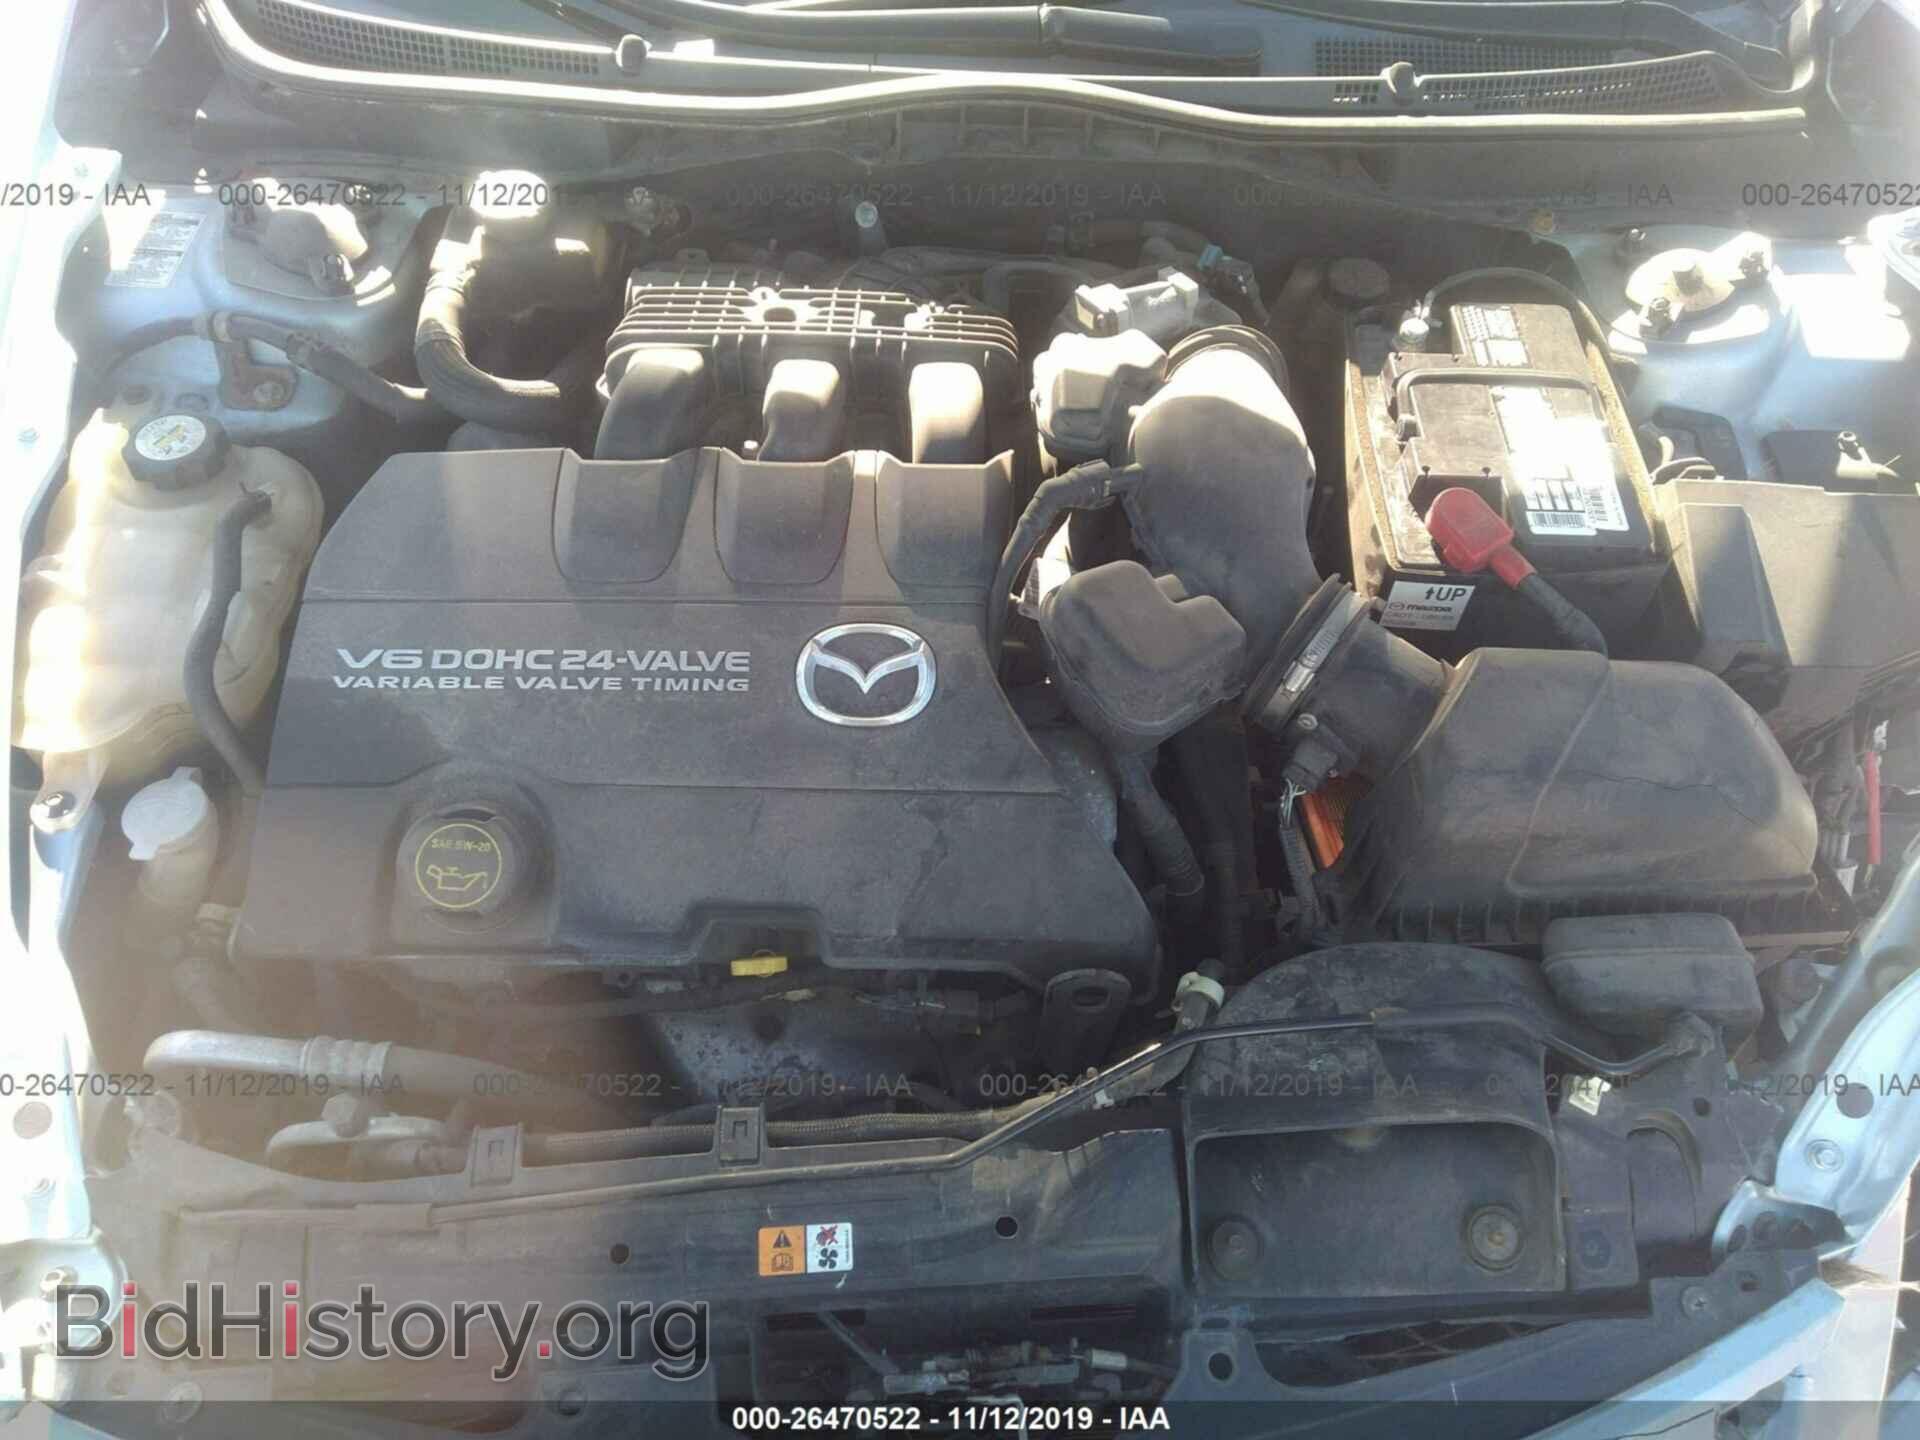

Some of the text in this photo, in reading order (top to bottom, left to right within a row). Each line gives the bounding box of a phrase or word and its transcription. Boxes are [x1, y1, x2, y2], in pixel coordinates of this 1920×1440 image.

[1435, 586, 1467, 601] UP
[336, 648, 751, 672] V6 DOHC 24-VALVE
[332, 675, 750, 692] VARIABLE VALVE TIMING
